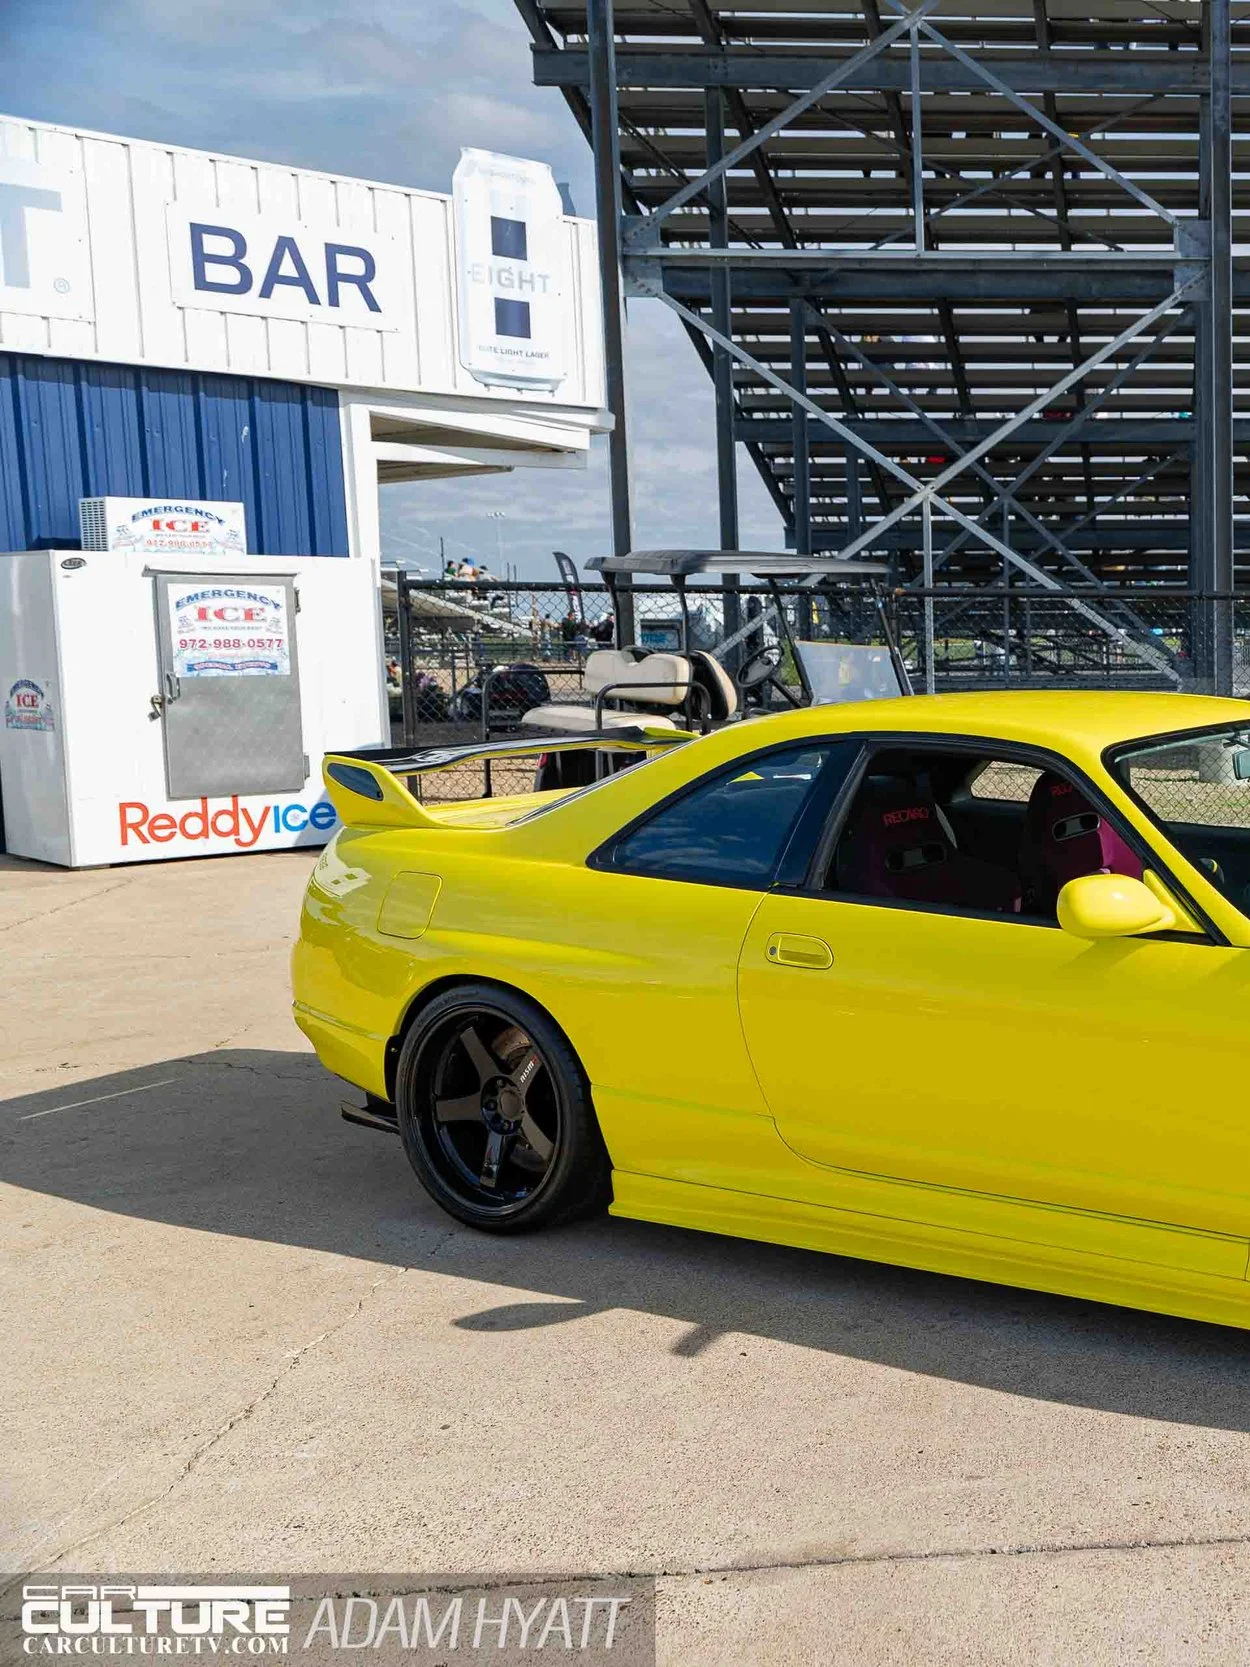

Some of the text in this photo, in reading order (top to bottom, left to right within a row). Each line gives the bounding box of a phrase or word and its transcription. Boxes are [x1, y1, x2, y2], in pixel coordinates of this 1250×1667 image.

[188, 221, 382, 314] BAR
[470, 262, 551, 294] EIGHT
[500, 348, 523, 357] LIGHT
[525, 350, 549, 359] LAGER
[131, 505, 225, 526] EMERGENCY
[150, 519, 210, 533] ICE
[175, 589, 282, 611] EMERGENCY
[194, 606, 267, 622] ICE
[16, 693, 39, 708] ICE
[883, 807, 929, 826] RECARO
